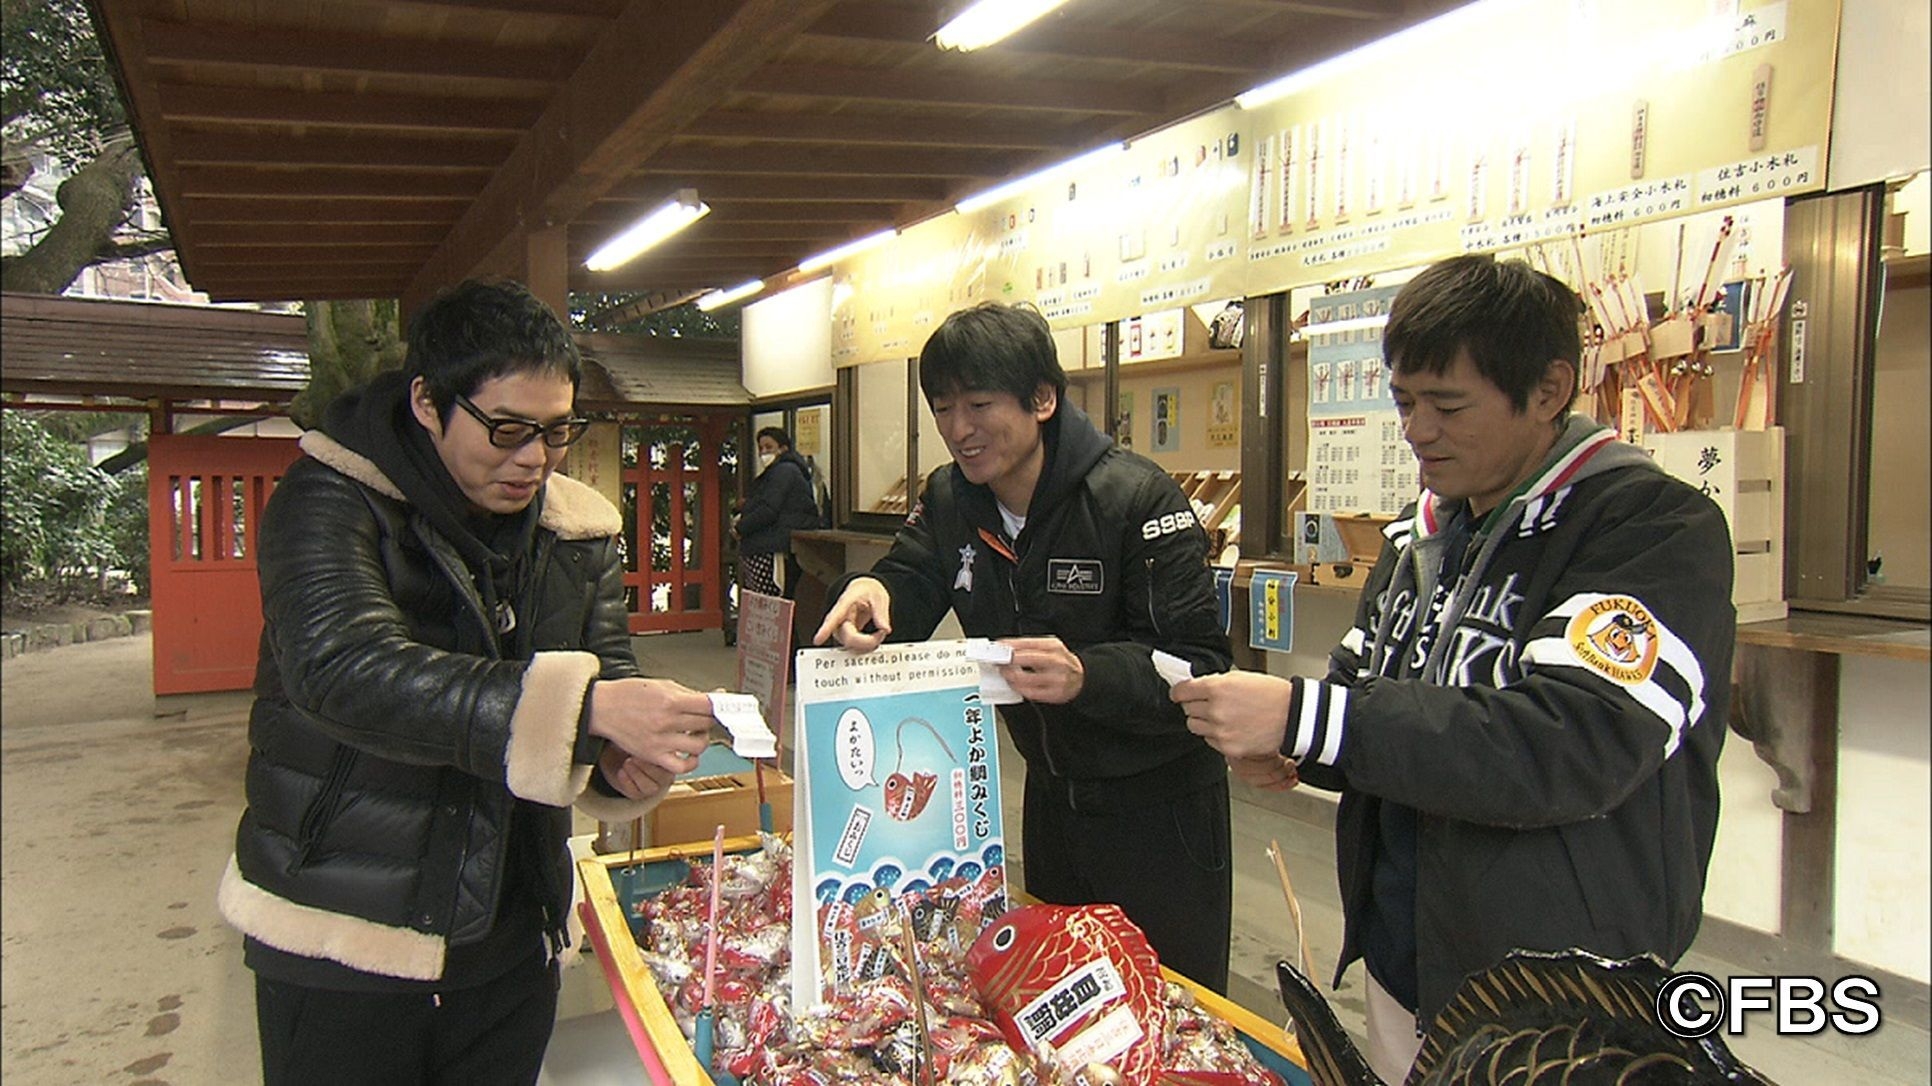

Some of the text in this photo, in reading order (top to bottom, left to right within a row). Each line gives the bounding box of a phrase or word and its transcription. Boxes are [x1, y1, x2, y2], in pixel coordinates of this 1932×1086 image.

[1589, 598, 1657, 642] FUKUOKA
[814, 674, 848, 688] touch
[855, 672, 902, 685] without
[815, 657, 836, 670] Per
[936, 649, 950, 659] do
[848, 720, 865, 778] よかたいっ
[961, 692, 990, 839] 一年よか鯛みくじ
